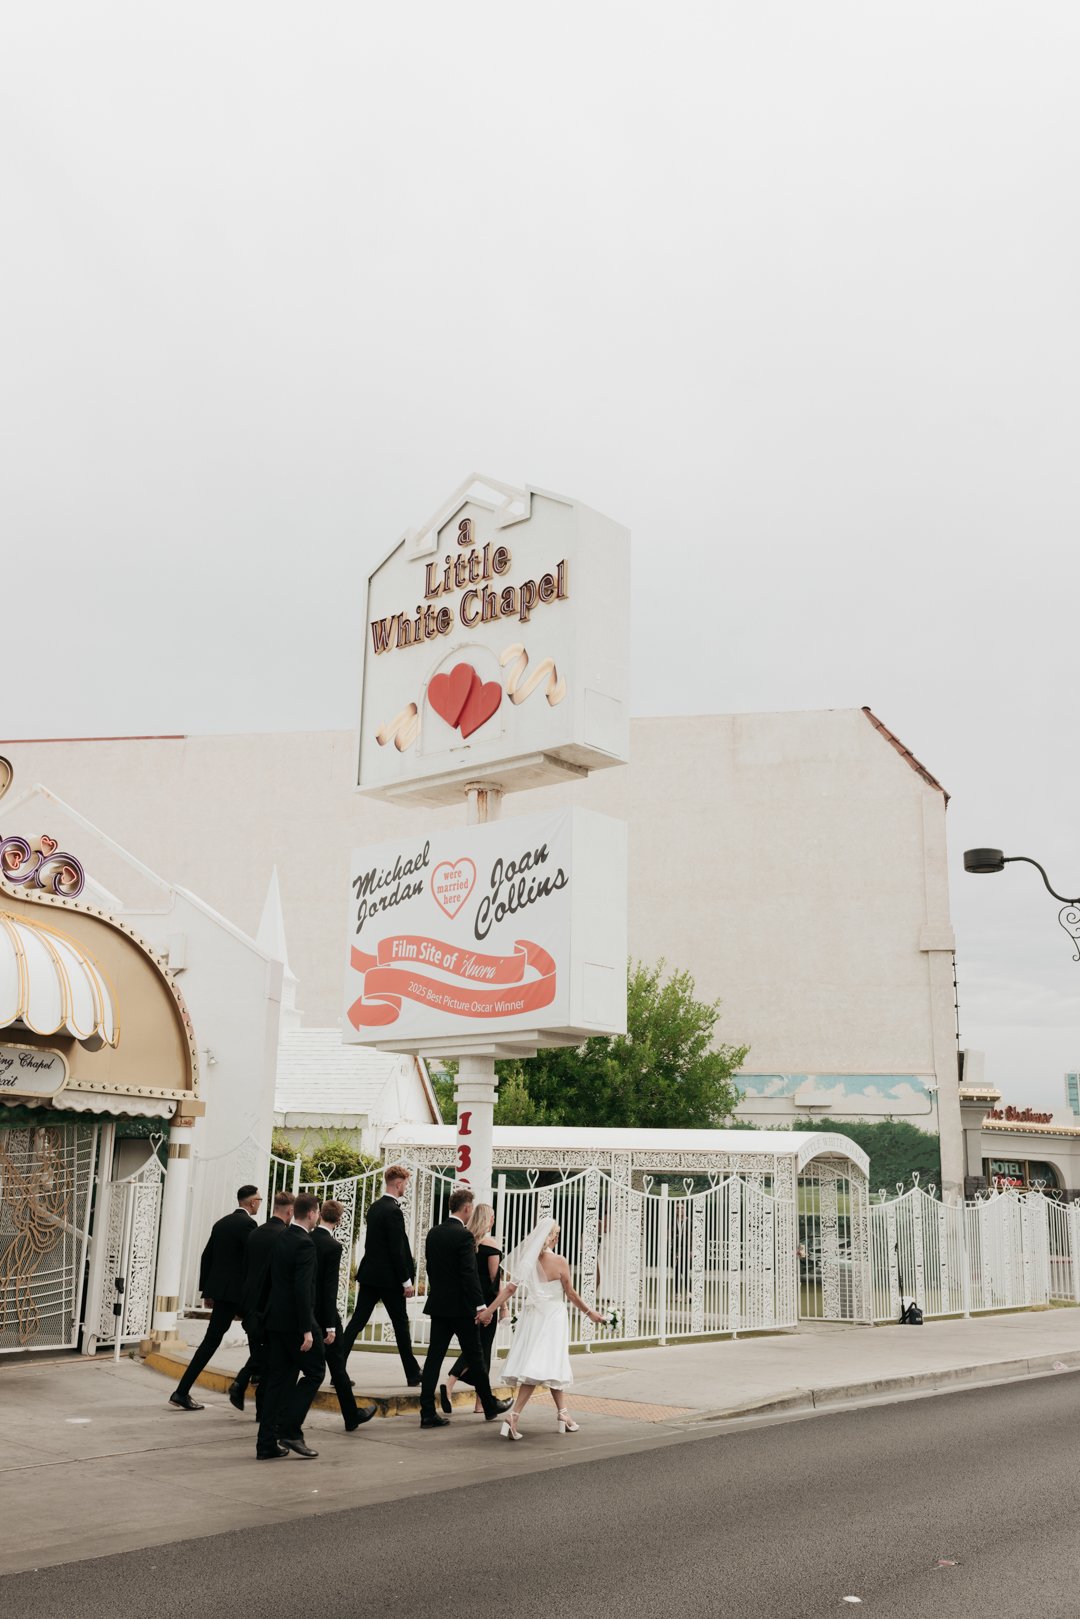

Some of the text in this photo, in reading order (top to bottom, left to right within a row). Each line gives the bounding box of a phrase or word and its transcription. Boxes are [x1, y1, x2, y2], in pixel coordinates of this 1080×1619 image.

[457, 518, 474, 547] a
[424, 542, 511, 600] Little
[370, 559, 568, 655] White Chapel
[352, 840, 430, 899] Michael
[437, 878, 469, 894] married
[443, 868, 462, 880] were
[490, 843, 549, 905] Joan
[356, 880, 423, 934] Jordan
[443, 893, 461, 905] here
[474, 868, 569, 940] Collins
[392, 940, 417, 959] Film
[420, 942, 442, 964] Site
[443, 953, 458, 969] of
[407, 981, 525, 1013] 2025 Best Picture Oscar Winner
[0, 1052, 55, 1073] ing Chapel
[456, 1111, 472, 1185] 13
